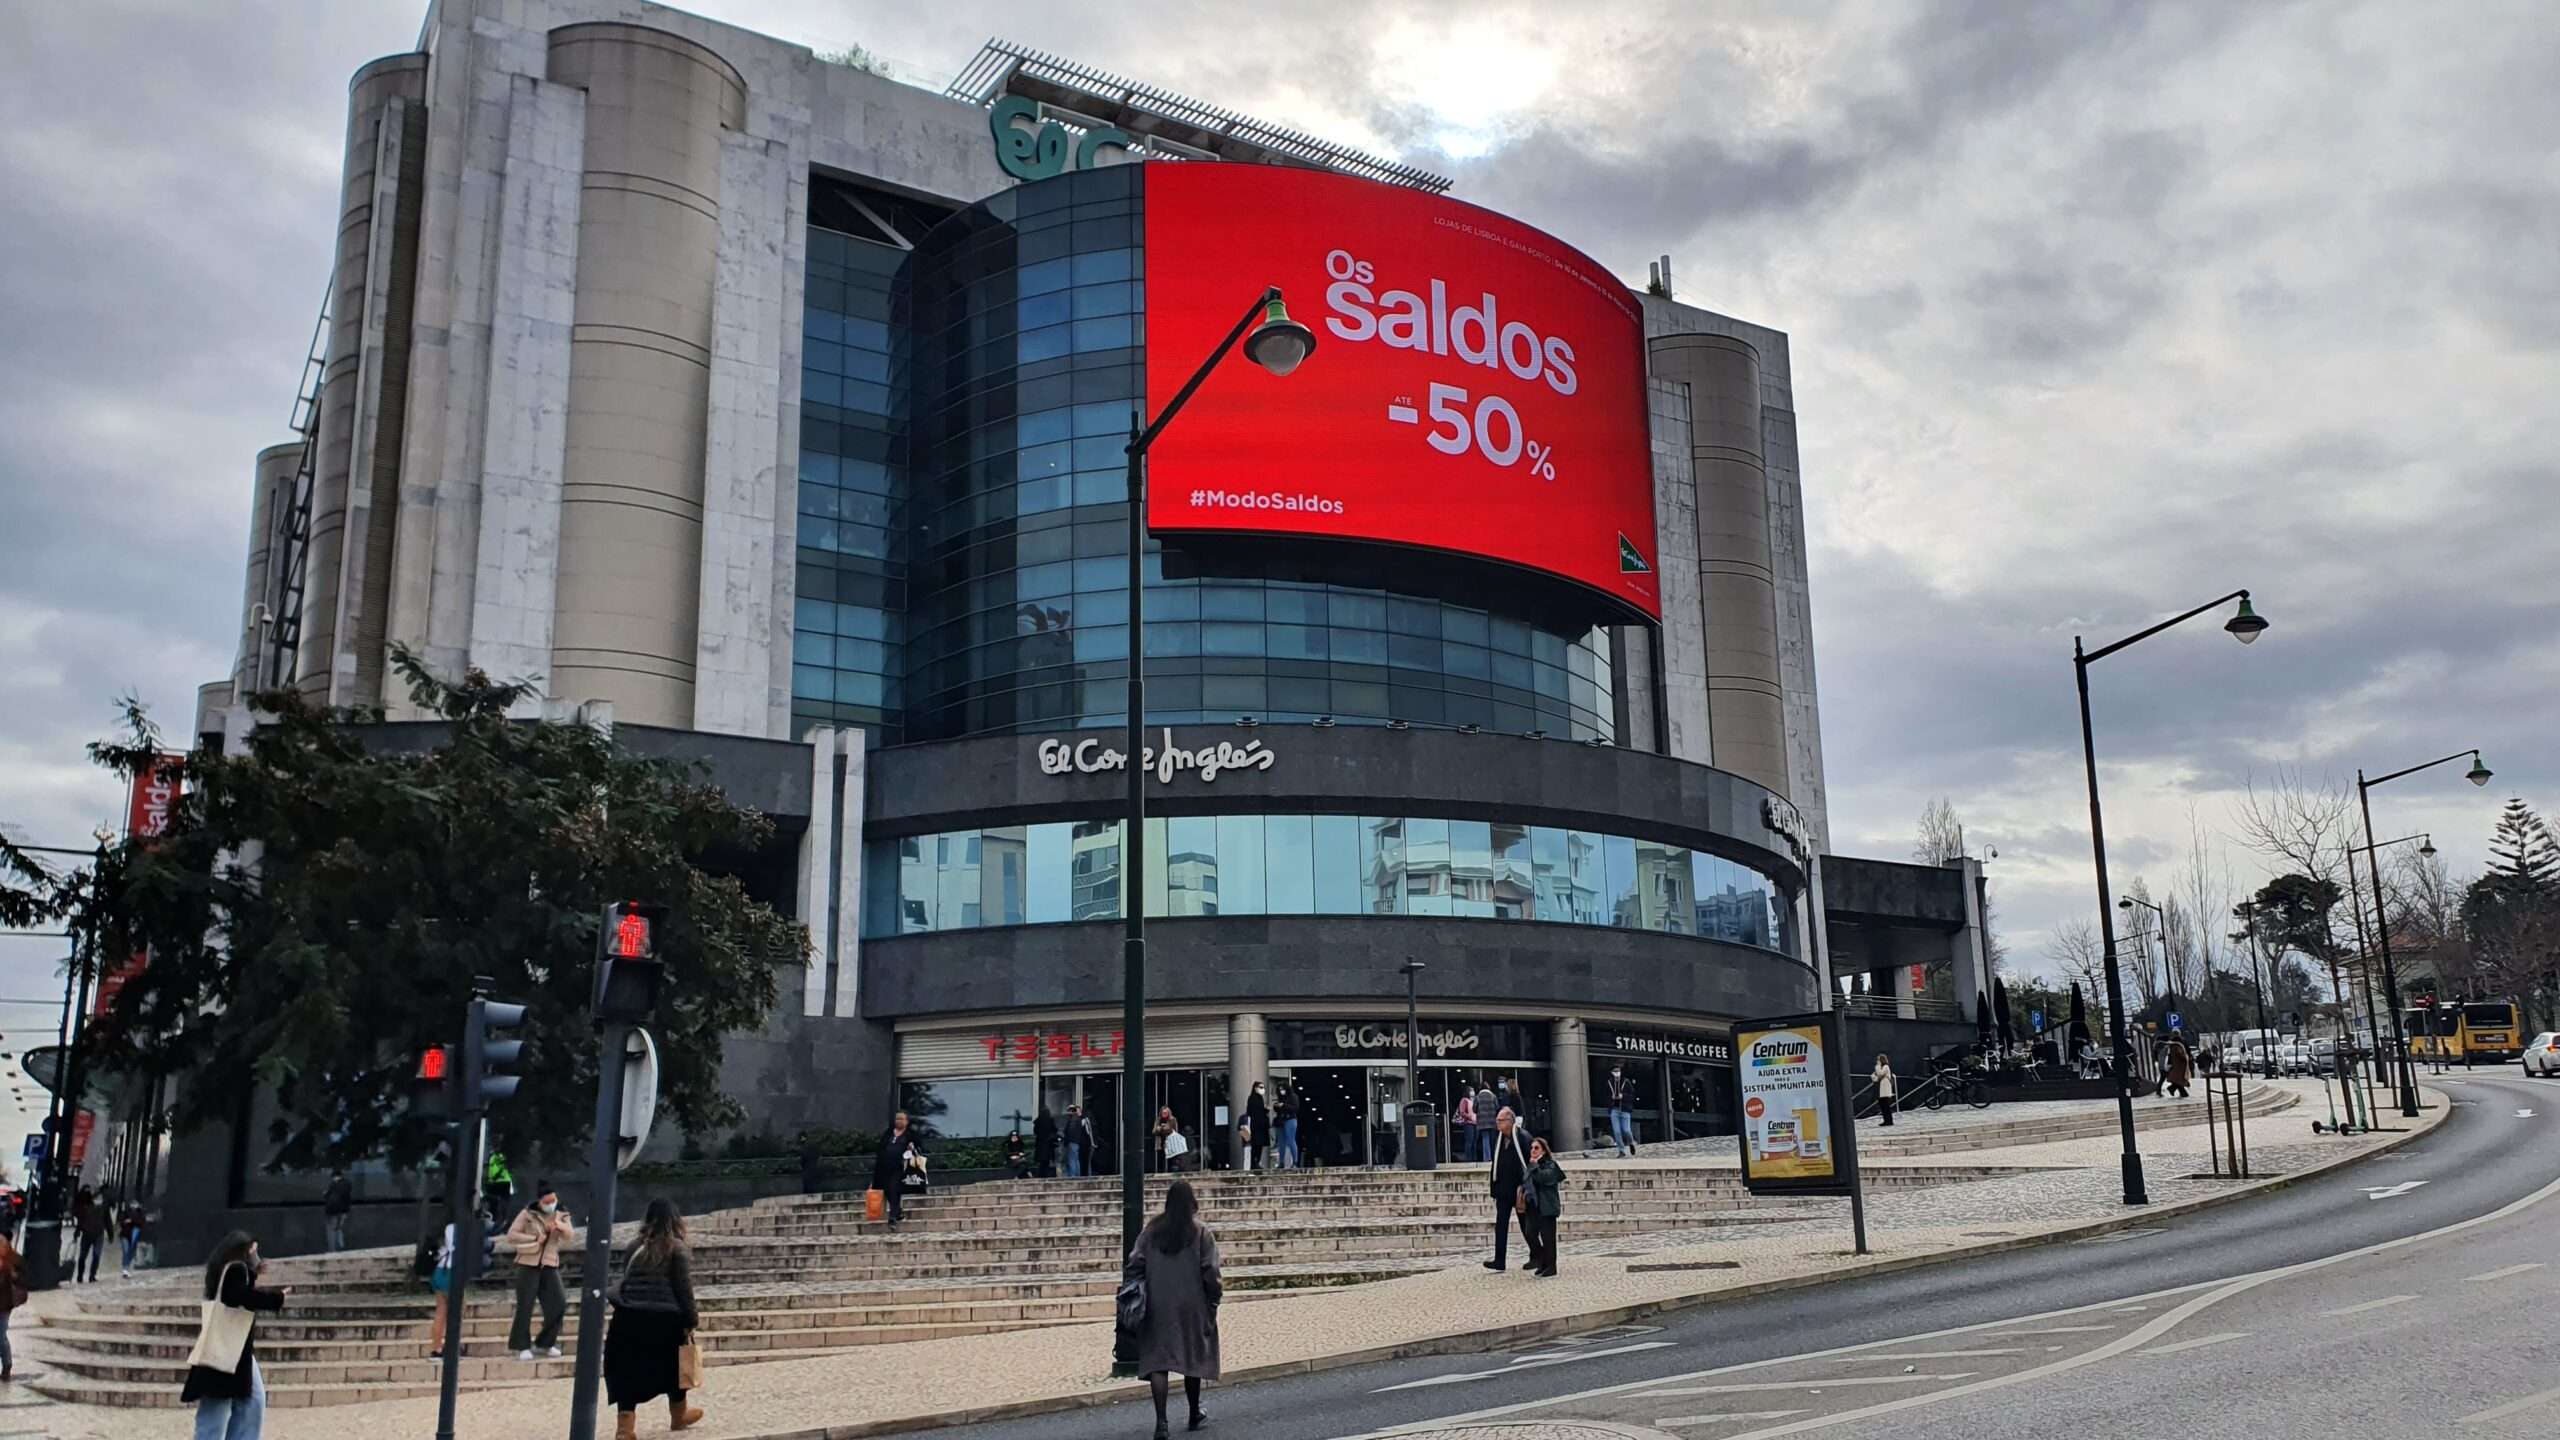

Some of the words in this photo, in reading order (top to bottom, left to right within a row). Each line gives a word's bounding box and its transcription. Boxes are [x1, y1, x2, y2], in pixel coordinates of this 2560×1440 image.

[1433, 216, 1460, 230] LOJAS
[1461, 223, 1473, 234] DE
[1474, 227, 1502, 243] LISBOA
[1326, 248, 1375, 284] Os
[1190, 489, 1344, 515] #ModoSaldos
[1038, 737, 1073, 775] El
[1074, 737, 1155, 774] Core
[1157, 727, 1276, 784] Inglés
[2170, 1014, 2180, 1025] P
[1334, 1024, 1358, 1049] El
[1358, 1025, 1409, 1049] Corte
[1615, 1036, 1686, 1056] STARBUCKS
[1686, 1043, 1729, 1060] COFFEE
[1752, 1040, 1809, 1059] Centrum
[1758, 1068, 1781, 1078] AJUDA
[1782, 1066, 1807, 1076] EXTRA
[1743, 1084, 1776, 1094] SISTEMA
[1777, 1078, 1824, 1091] IMUNITÁRIO
[31, 1137, 43, 1150] P
